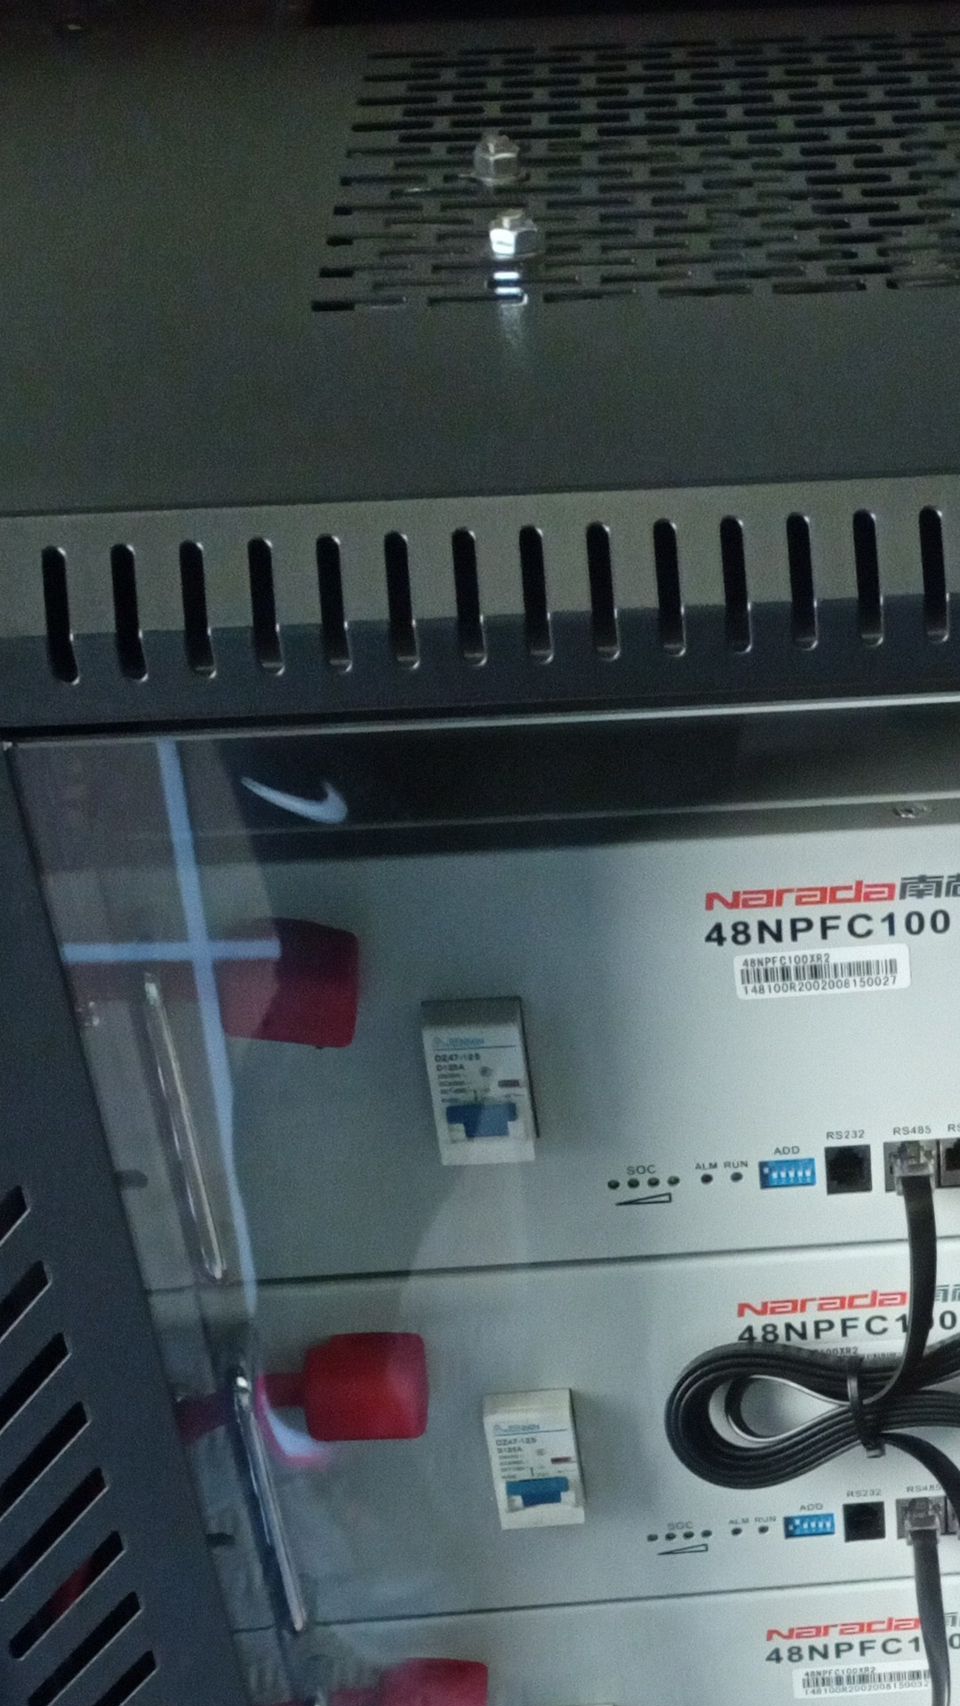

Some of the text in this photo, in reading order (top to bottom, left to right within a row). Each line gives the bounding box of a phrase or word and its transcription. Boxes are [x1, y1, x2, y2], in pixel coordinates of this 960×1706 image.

[705, 880, 896, 911] Narada
[704, 909, 951, 947] 48NPFC100
[826, 1129, 866, 1140] RS232
[893, 1125, 932, 1135] RS485
[774, 1146, 800, 1155] ADD
[626, 1164, 657, 1175] SOC
[695, 1162, 718, 1170] ALM
[724, 1160, 749, 1169] RUN
[737, 1290, 908, 1317] Narada
[737, 1310, 957, 1344] 48NPFC10
[846, 1489, 882, 1498] RS232
[799, 1503, 824, 1511] ADD
[766, 1617, 922, 1641] Narada
